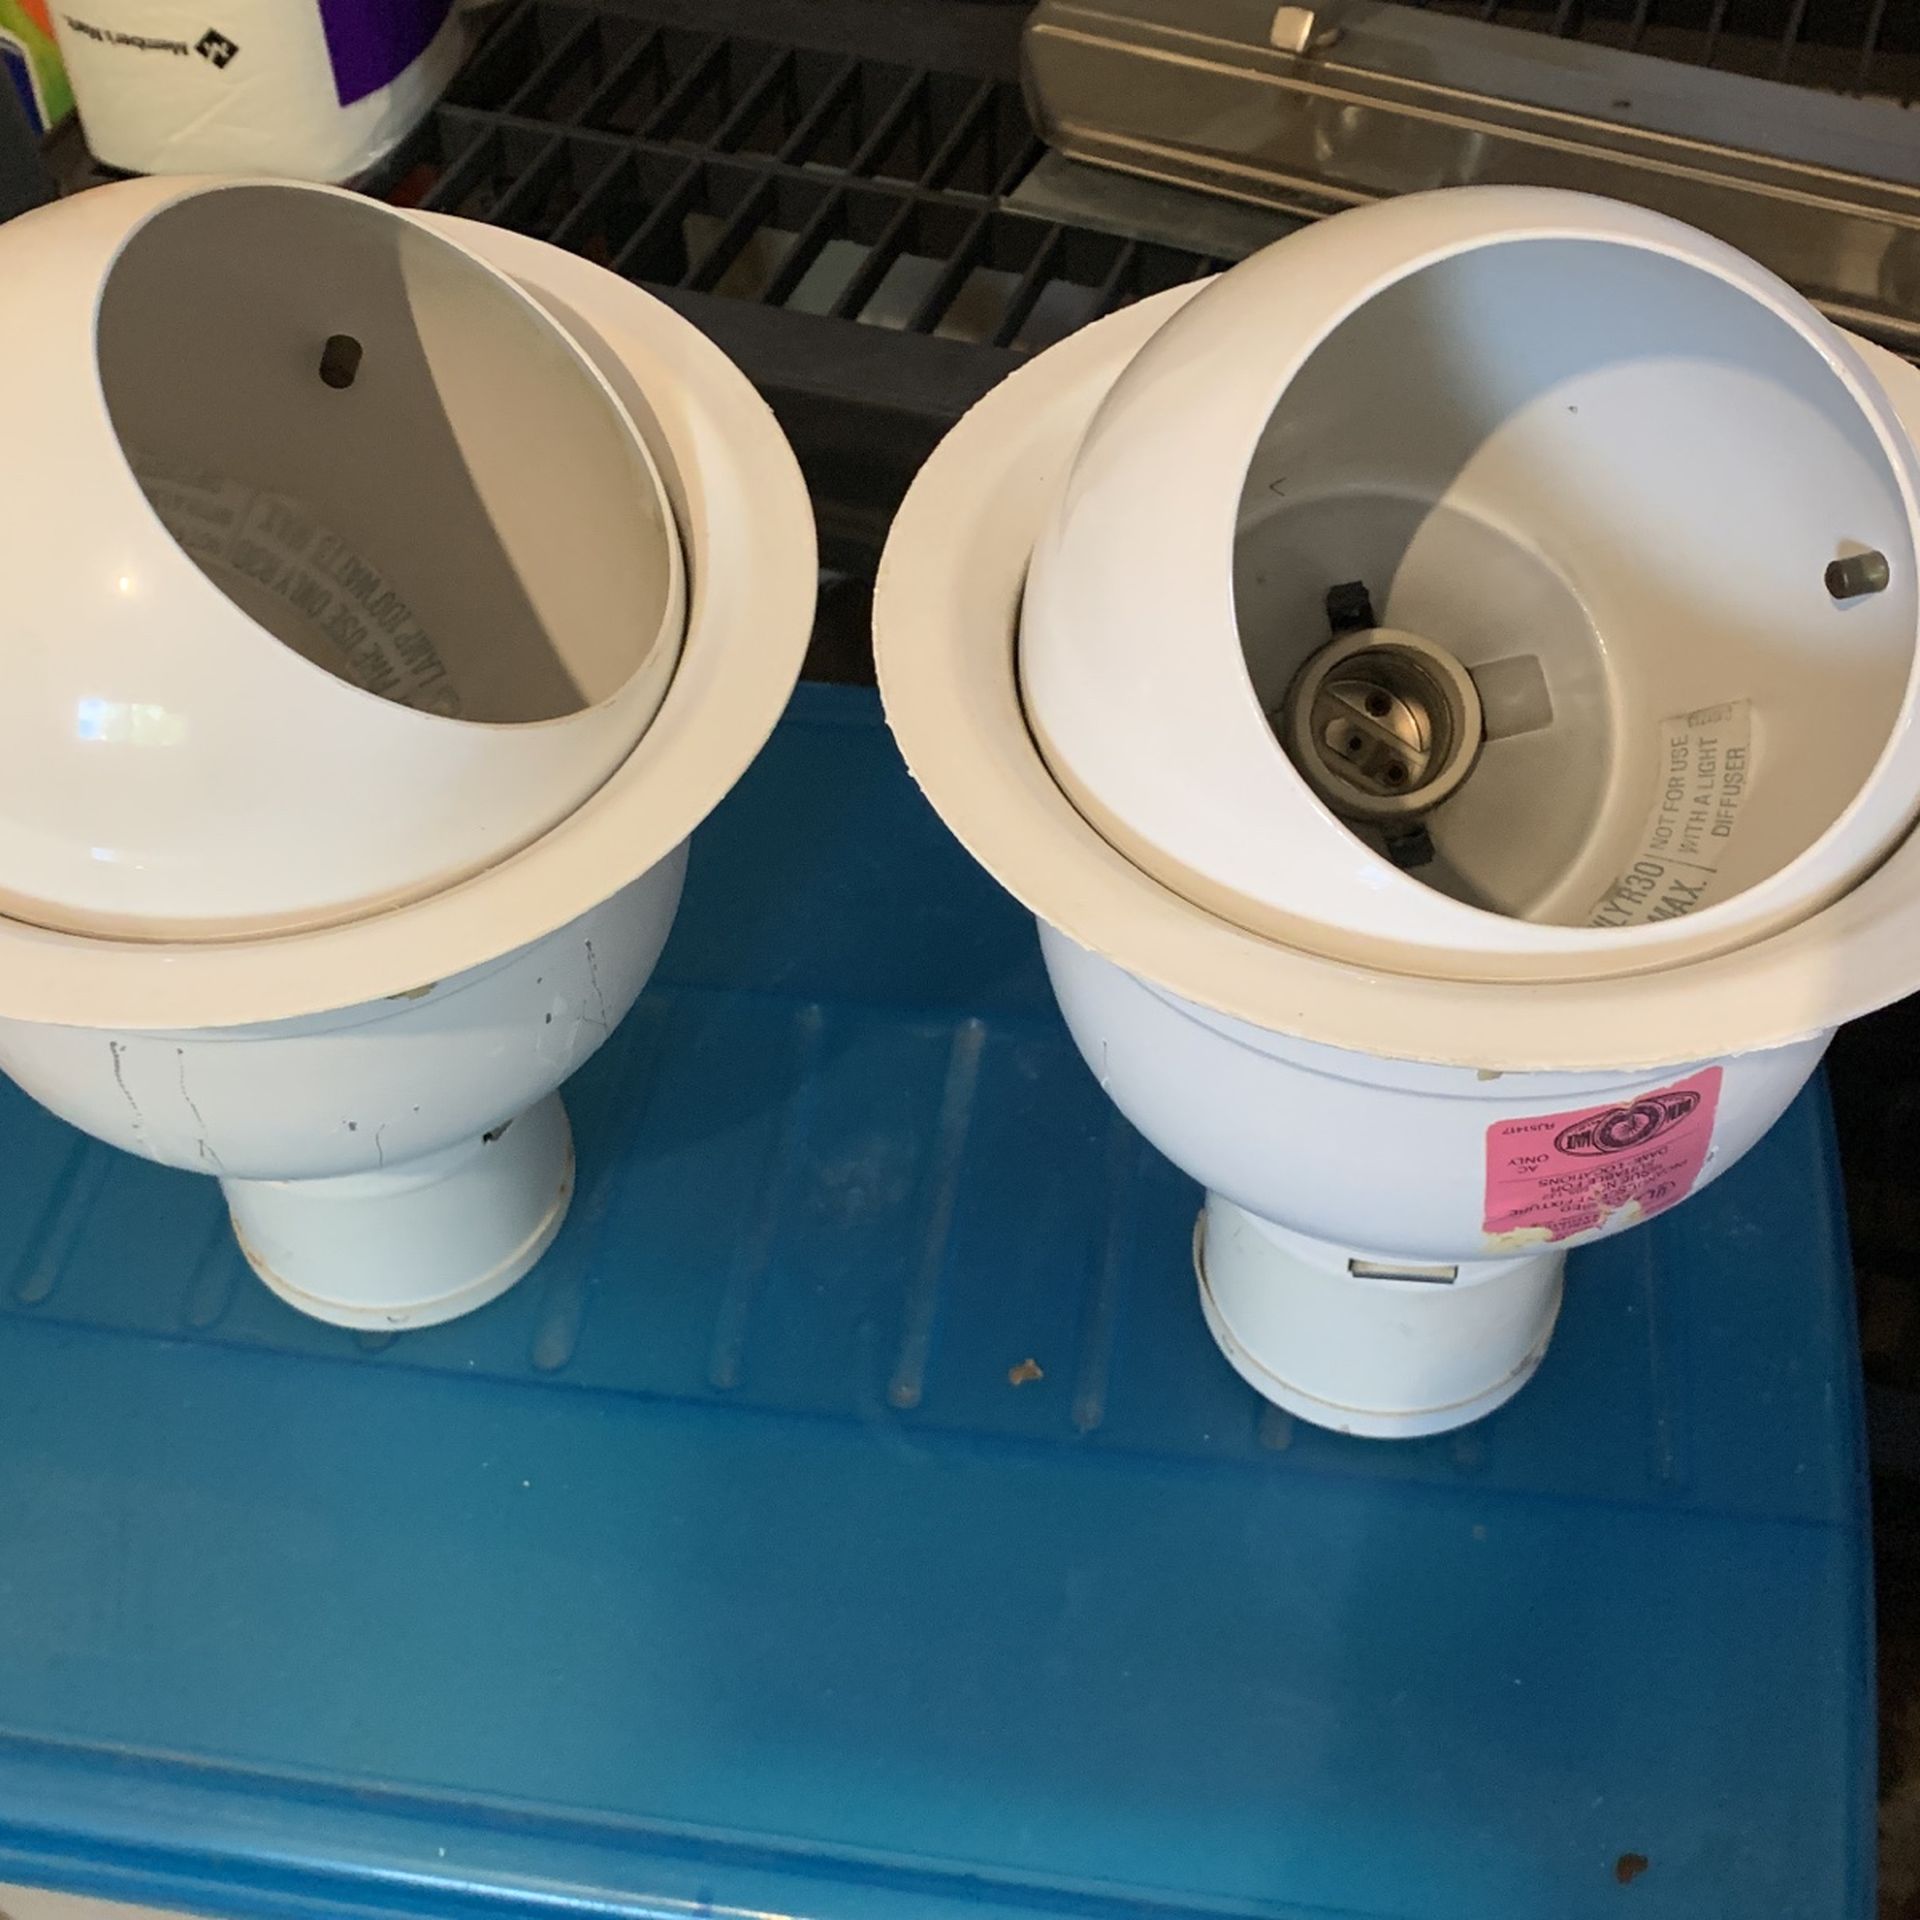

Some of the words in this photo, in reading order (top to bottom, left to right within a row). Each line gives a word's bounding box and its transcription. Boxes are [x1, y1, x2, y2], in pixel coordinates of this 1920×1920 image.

[105, 30, 188, 55] Member's
[320, 604, 369, 653] USE
[370, 591, 412, 633] 100
[393, 628, 447, 688] LAMP
[1670, 735, 1689, 772] USE
[1697, 736, 1718, 790] LIGHT
[1662, 776, 1685, 813] FOR
[1694, 794, 1711, 806] A
[1711, 747, 1746, 838] DIFFUSER
[1650, 815, 1676, 850] NOT
[1678, 809, 1709, 854] WITH
[1618, 861, 1665, 905] R30
[1647, 879, 1708, 923] MAX.
[1507, 1153, 1549, 1167] ONLY
[1517, 1164, 1539, 1174] AC
[1538, 1162, 1624, 1187] LOCATIONS
[1511, 1198, 1573, 1217] FIXTURE
